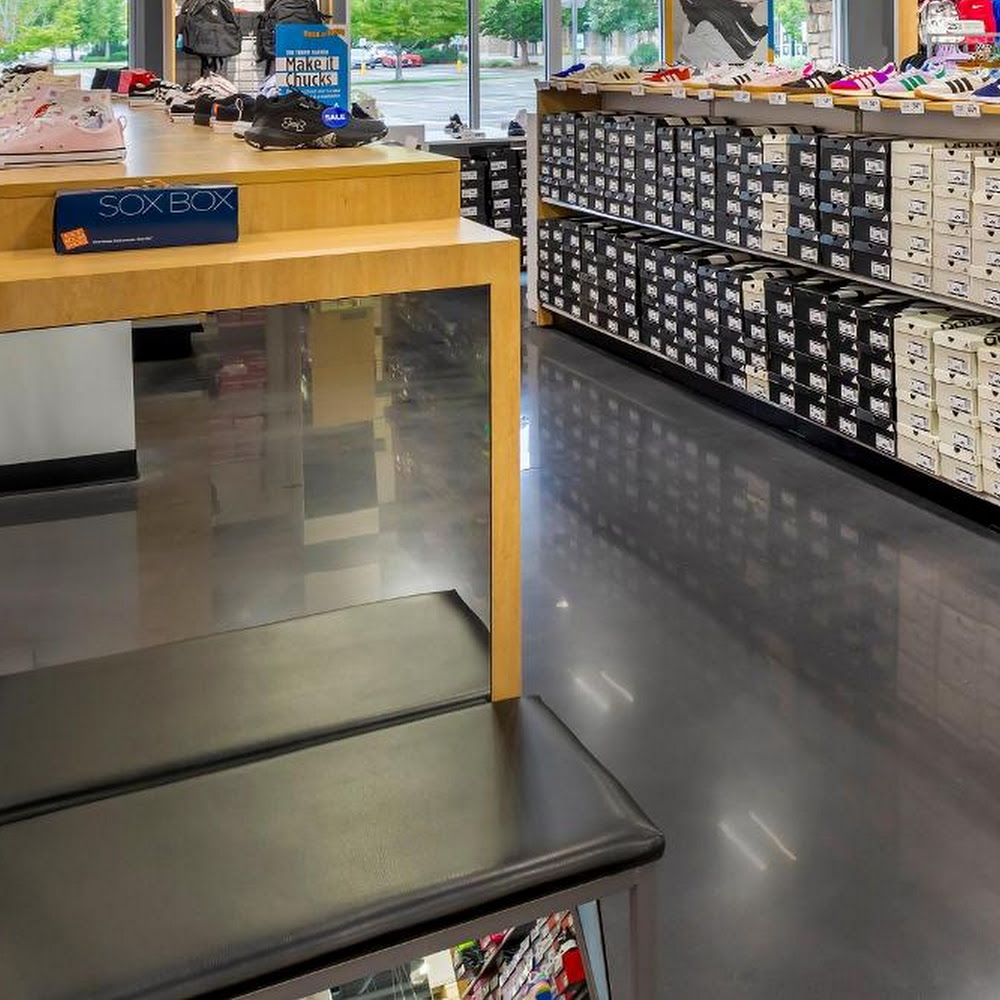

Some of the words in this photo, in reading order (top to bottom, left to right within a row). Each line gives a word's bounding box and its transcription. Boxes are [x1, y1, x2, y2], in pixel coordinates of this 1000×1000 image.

[286, 57, 322, 71] Make
[325, 57, 335, 71] it
[286, 72, 333, 87] Chucks
[324, 113, 346, 121] SALE
[99, 193, 163, 218] SOX
[169, 189, 234, 213] BOX
